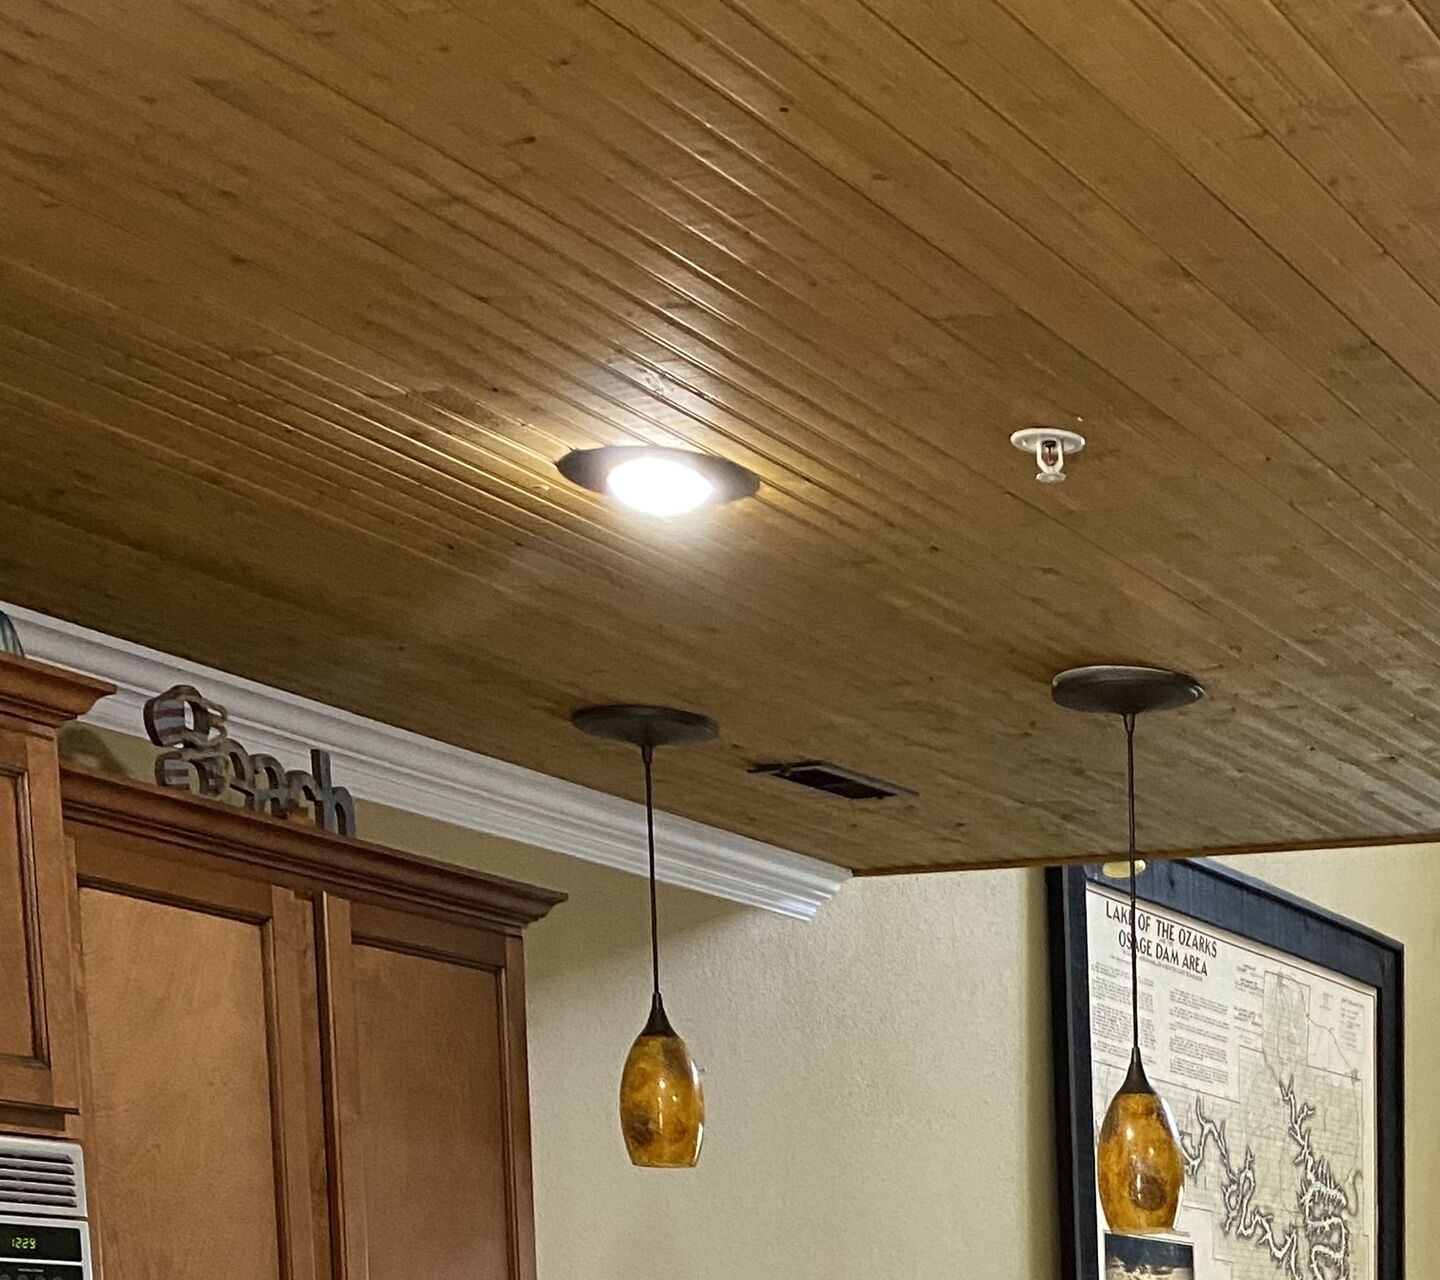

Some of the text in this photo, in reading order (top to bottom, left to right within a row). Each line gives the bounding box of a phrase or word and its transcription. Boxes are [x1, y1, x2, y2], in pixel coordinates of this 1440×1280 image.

[1138, 913, 1151, 932] OF
[1156, 920, 1175, 941] THE
[1178, 929, 1217, 958] OZARKS
[1155, 943, 1179, 966] DAM
[1182, 953, 1208, 977] AREA
